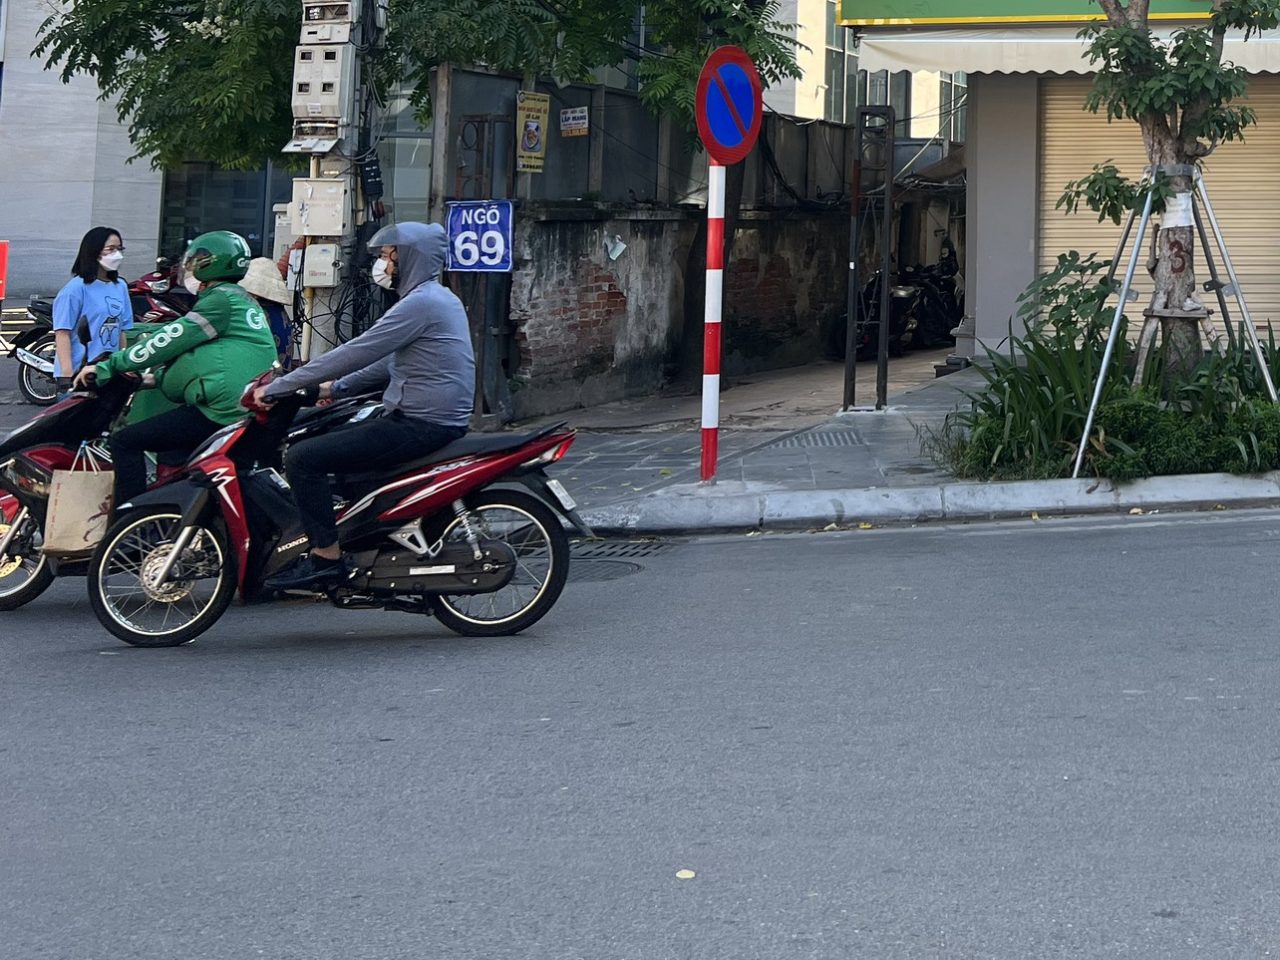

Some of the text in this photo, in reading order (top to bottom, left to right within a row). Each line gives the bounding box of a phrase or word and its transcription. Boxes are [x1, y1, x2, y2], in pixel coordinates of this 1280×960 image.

[461, 204, 500, 225] NGÕ
[454, 230, 505, 266] 69
[128, 322, 184, 364] Grab
